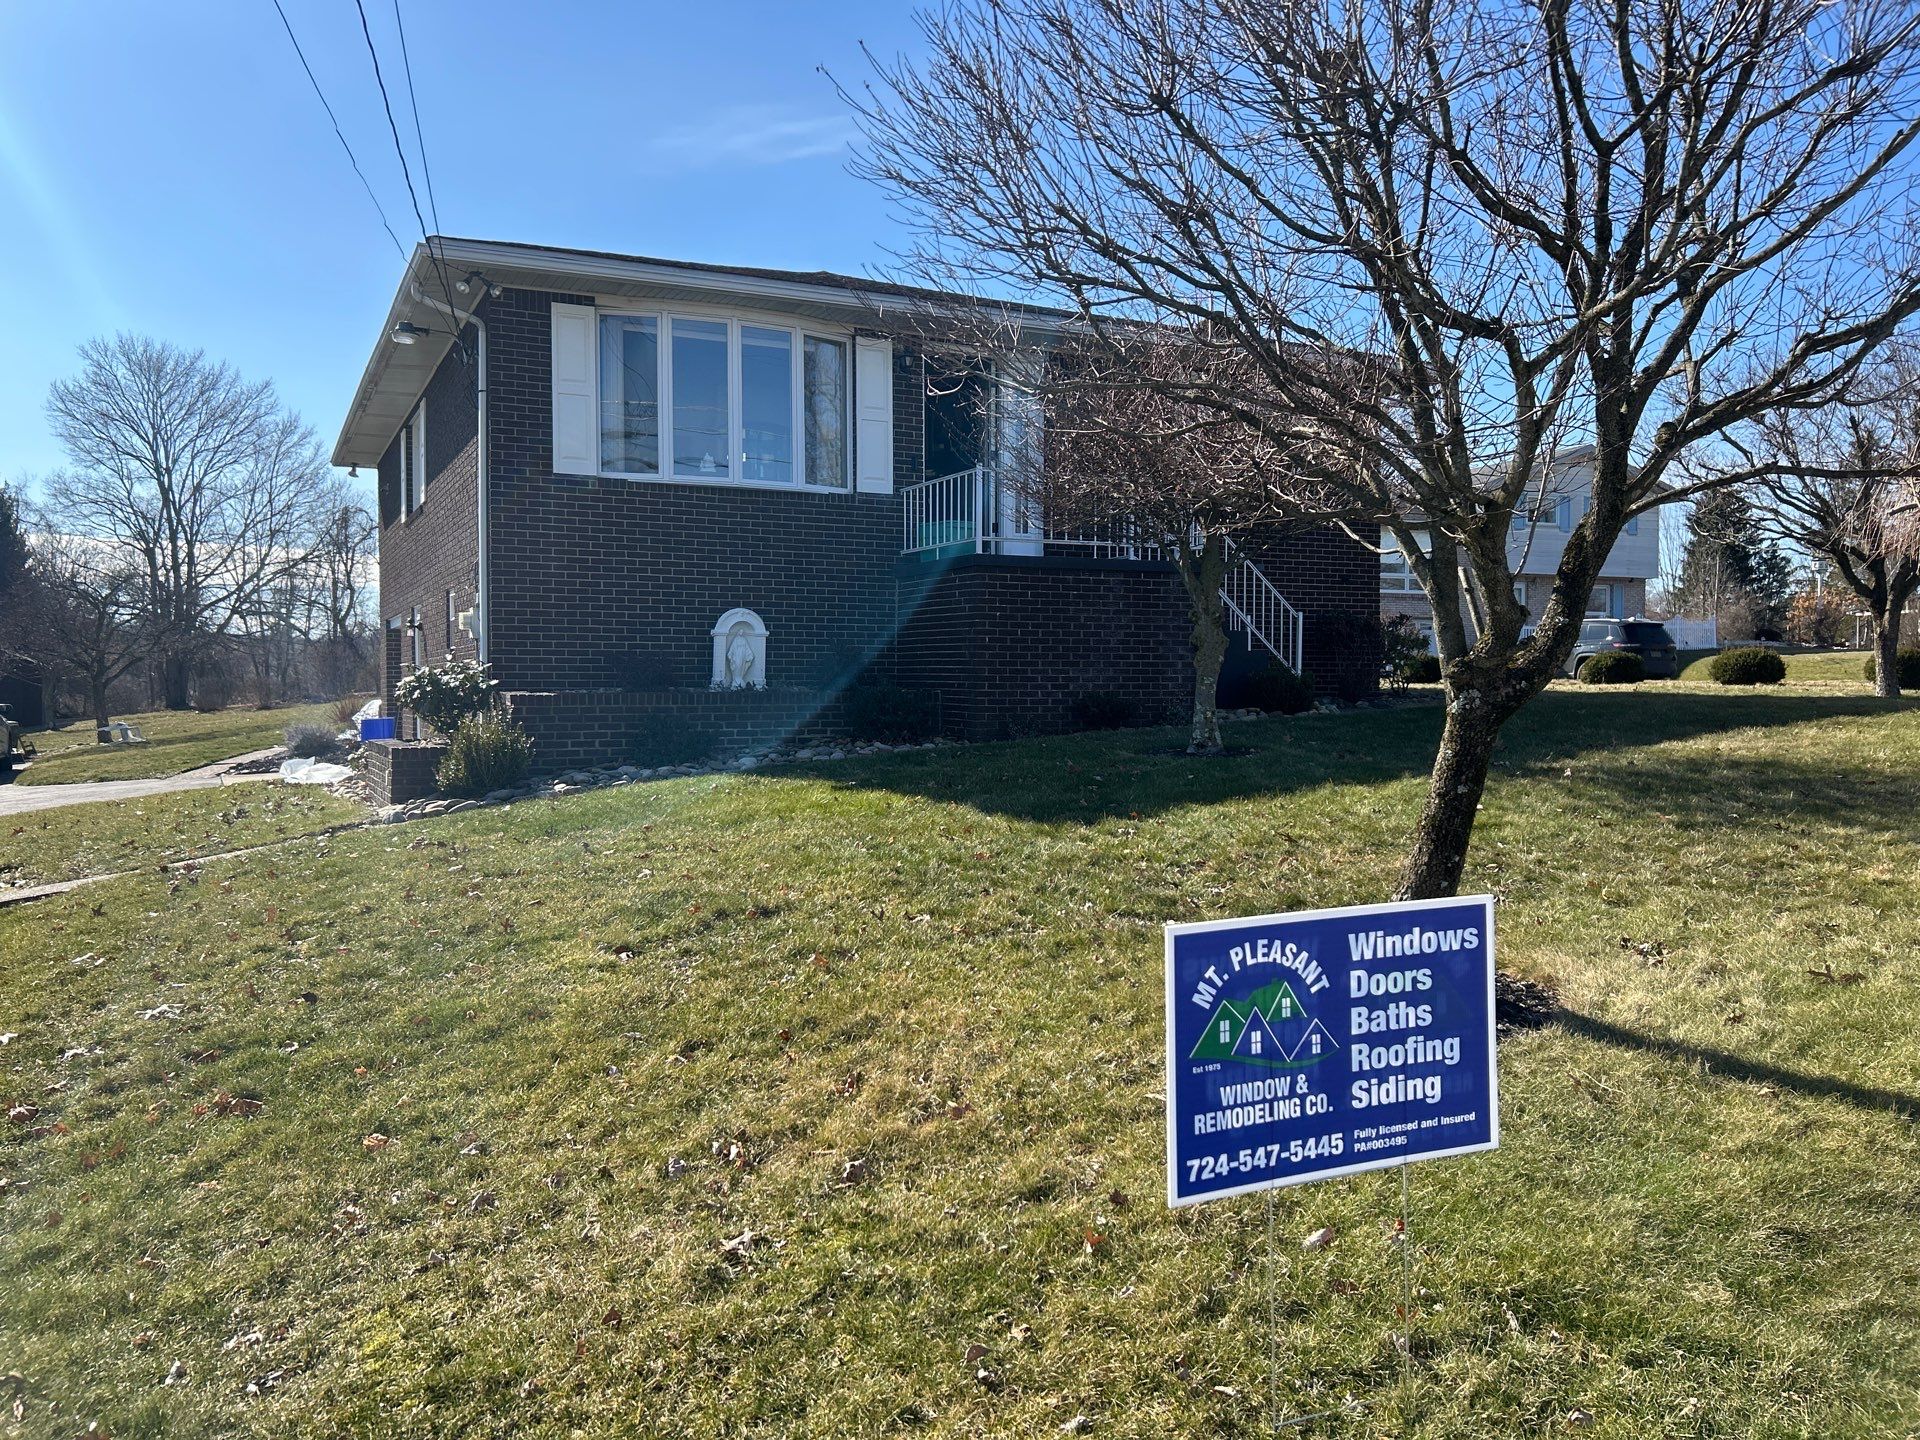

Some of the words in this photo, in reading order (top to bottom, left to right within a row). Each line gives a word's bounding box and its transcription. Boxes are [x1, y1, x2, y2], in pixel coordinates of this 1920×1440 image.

[1348, 927, 1478, 961] Windows
[1192, 966, 1229, 1010] MT.
[1230, 939, 1329, 994] PLEASANT
[1350, 969, 1432, 998] Doors
[1351, 1001, 1432, 1035] Baths
[1205, 1063, 1220, 1071] 1975
[1352, 1036, 1460, 1071] Roofing
[1220, 1076, 1291, 1107] WINDOW
[1296, 1074, 1308, 1094] &
[1352, 1075, 1441, 1108] Siding
[1195, 1097, 1300, 1134] REMODELING
[1306, 1094, 1333, 1115] CO.
[1354, 1128, 1377, 1139] Fully
[1379, 1120, 1418, 1135] licensed
[1421, 1117, 1438, 1128] and
[1441, 1112, 1475, 1125] Insured
[1187, 1133, 1344, 1182] 724-547-5445
[1354, 1135, 1407, 1152] PA#003495
